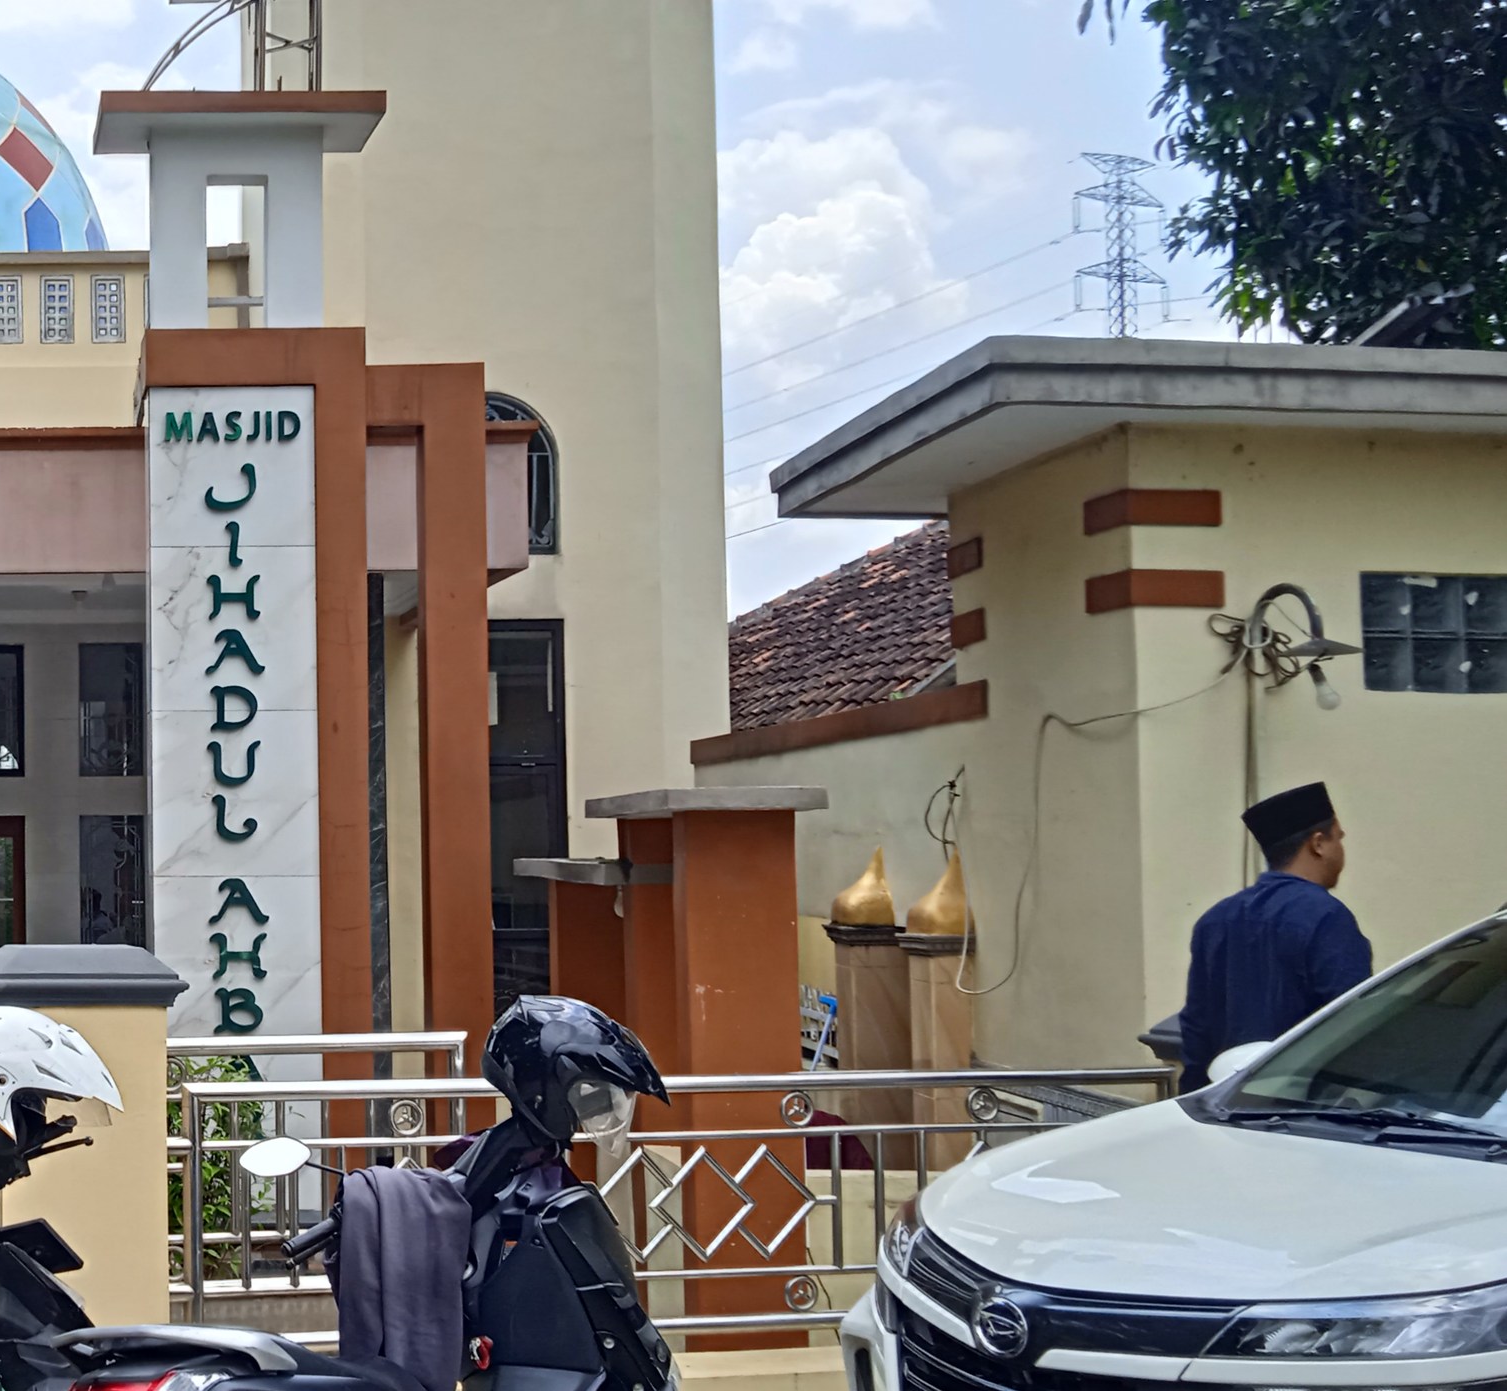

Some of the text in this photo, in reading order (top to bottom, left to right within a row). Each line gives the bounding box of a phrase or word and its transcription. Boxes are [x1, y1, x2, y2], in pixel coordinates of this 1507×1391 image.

[165, 410, 301, 442] MASJID
[204, 463, 270, 1138] JIHADUL AHB
